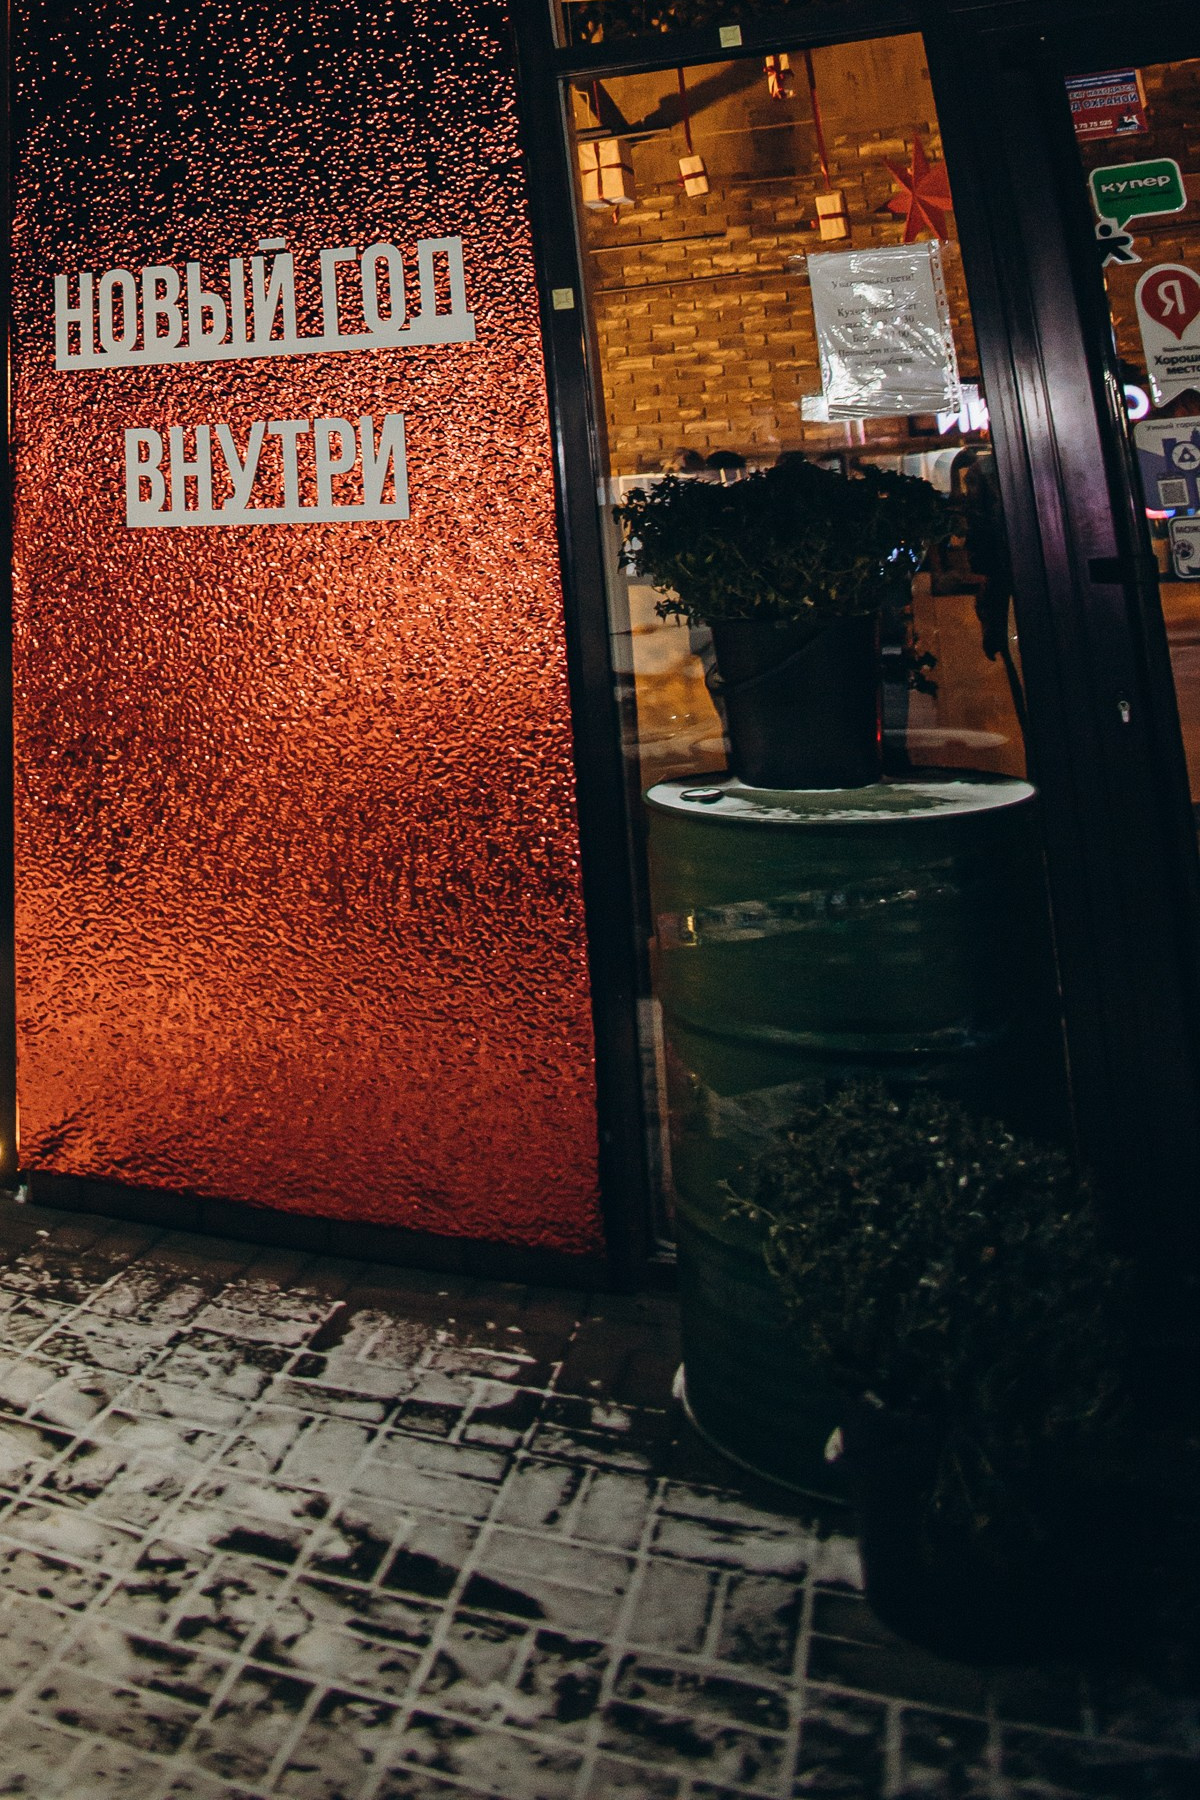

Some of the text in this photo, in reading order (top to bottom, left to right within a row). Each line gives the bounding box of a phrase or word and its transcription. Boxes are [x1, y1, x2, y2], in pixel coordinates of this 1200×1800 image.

[1101, 175, 1171, 193] купер
[54, 236, 476, 370] НОВЫЙ ГОД
[1157, 280, 1186, 317] Я
[125, 413, 410, 528] ВНУТРИ
